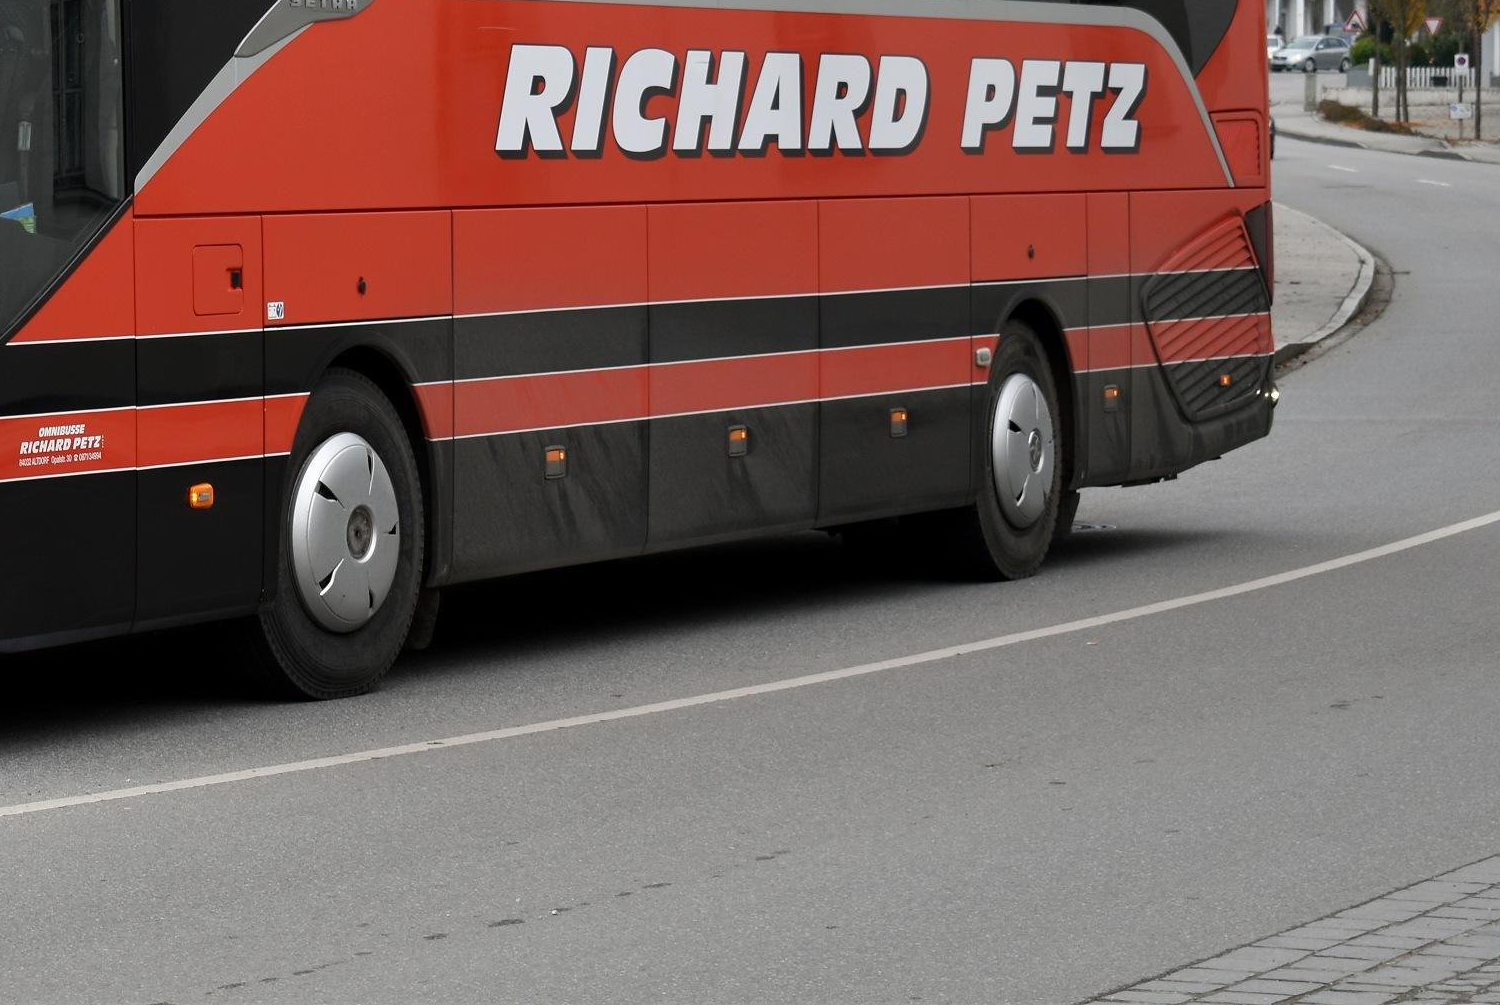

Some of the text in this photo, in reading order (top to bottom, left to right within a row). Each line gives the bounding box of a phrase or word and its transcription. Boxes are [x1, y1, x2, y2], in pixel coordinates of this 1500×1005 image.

[494, 43, 1148, 159] RICHARD PETZ
[38, 424, 85, 437] OMNIBUSSE
[20, 438, 71, 454] RICHARD
[73, 436, 102, 450] PETZ
